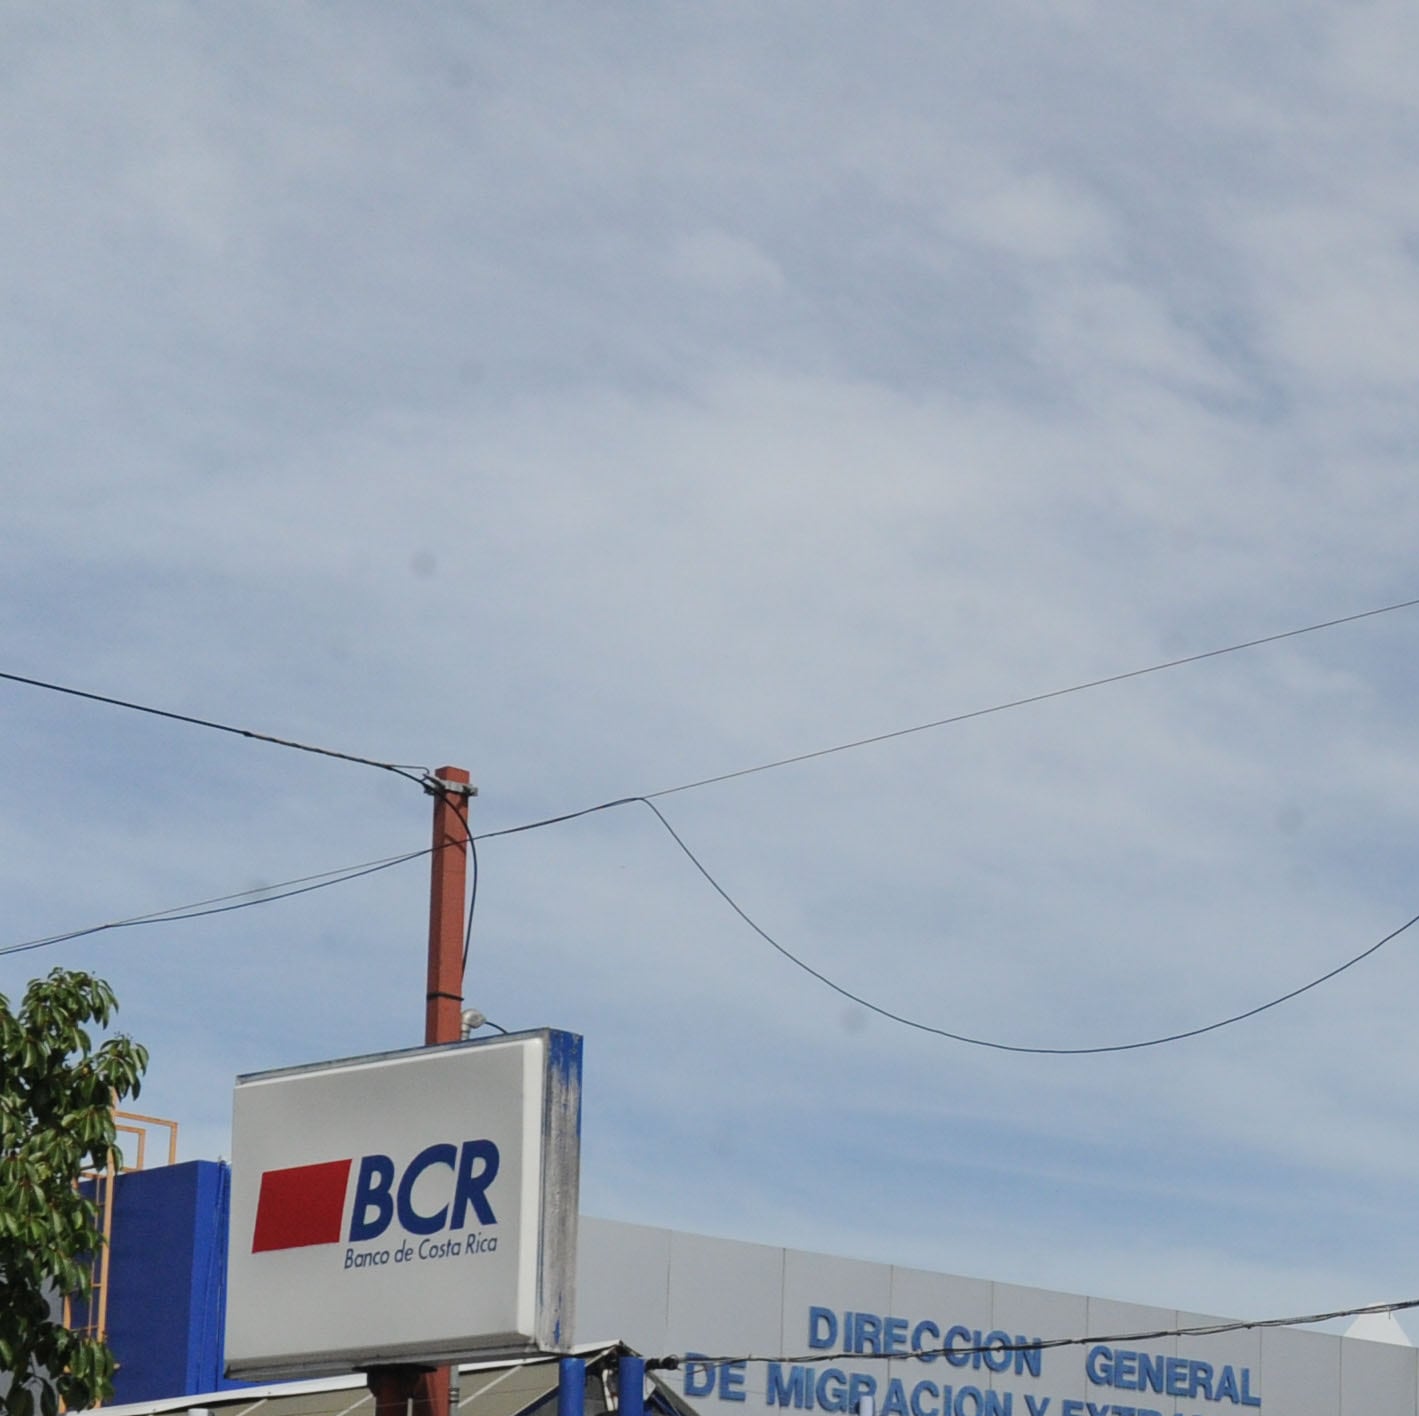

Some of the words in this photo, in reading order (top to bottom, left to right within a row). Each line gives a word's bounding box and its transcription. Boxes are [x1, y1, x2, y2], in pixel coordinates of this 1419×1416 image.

[347, 1138, 501, 1243] BCR
[343, 1248, 391, 1270] Banco
[394, 1239, 415, 1263] de
[418, 1238, 462, 1260] Costa
[465, 1231, 499, 1255] Rica
[684, 1351, 747, 1402] DE
[808, 1305, 1042, 1378] DIRECCION
[1085, 1344, 1263, 1408] GENERAL
